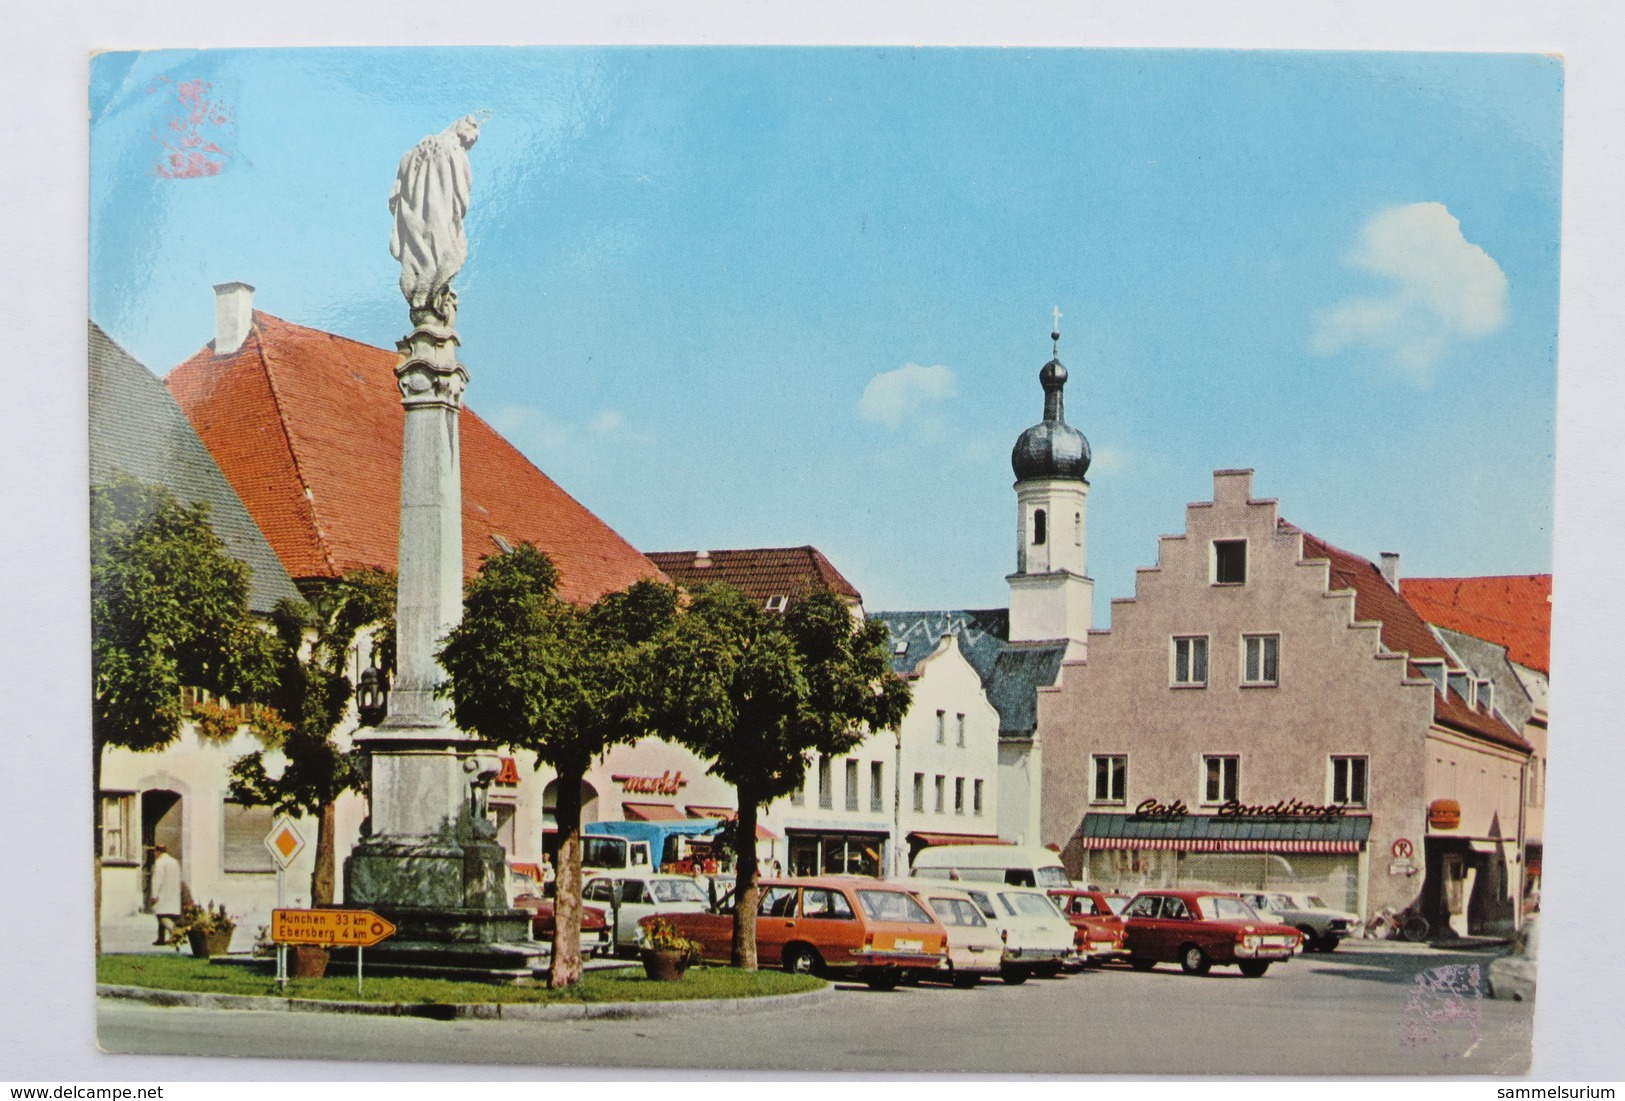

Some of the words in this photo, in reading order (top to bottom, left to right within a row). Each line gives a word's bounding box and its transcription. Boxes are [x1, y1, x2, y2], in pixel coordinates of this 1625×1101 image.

[495, 757, 519, 783] A
[1135, 798, 1189, 818] Cafe
[1218, 797, 1348, 819] Conditorei
[336, 914, 349, 925] 33
[353, 915, 367, 926] km
[280, 926, 335, 942] Ebersberg
[342, 928, 349, 939] 4
[353, 929, 367, 940] km
